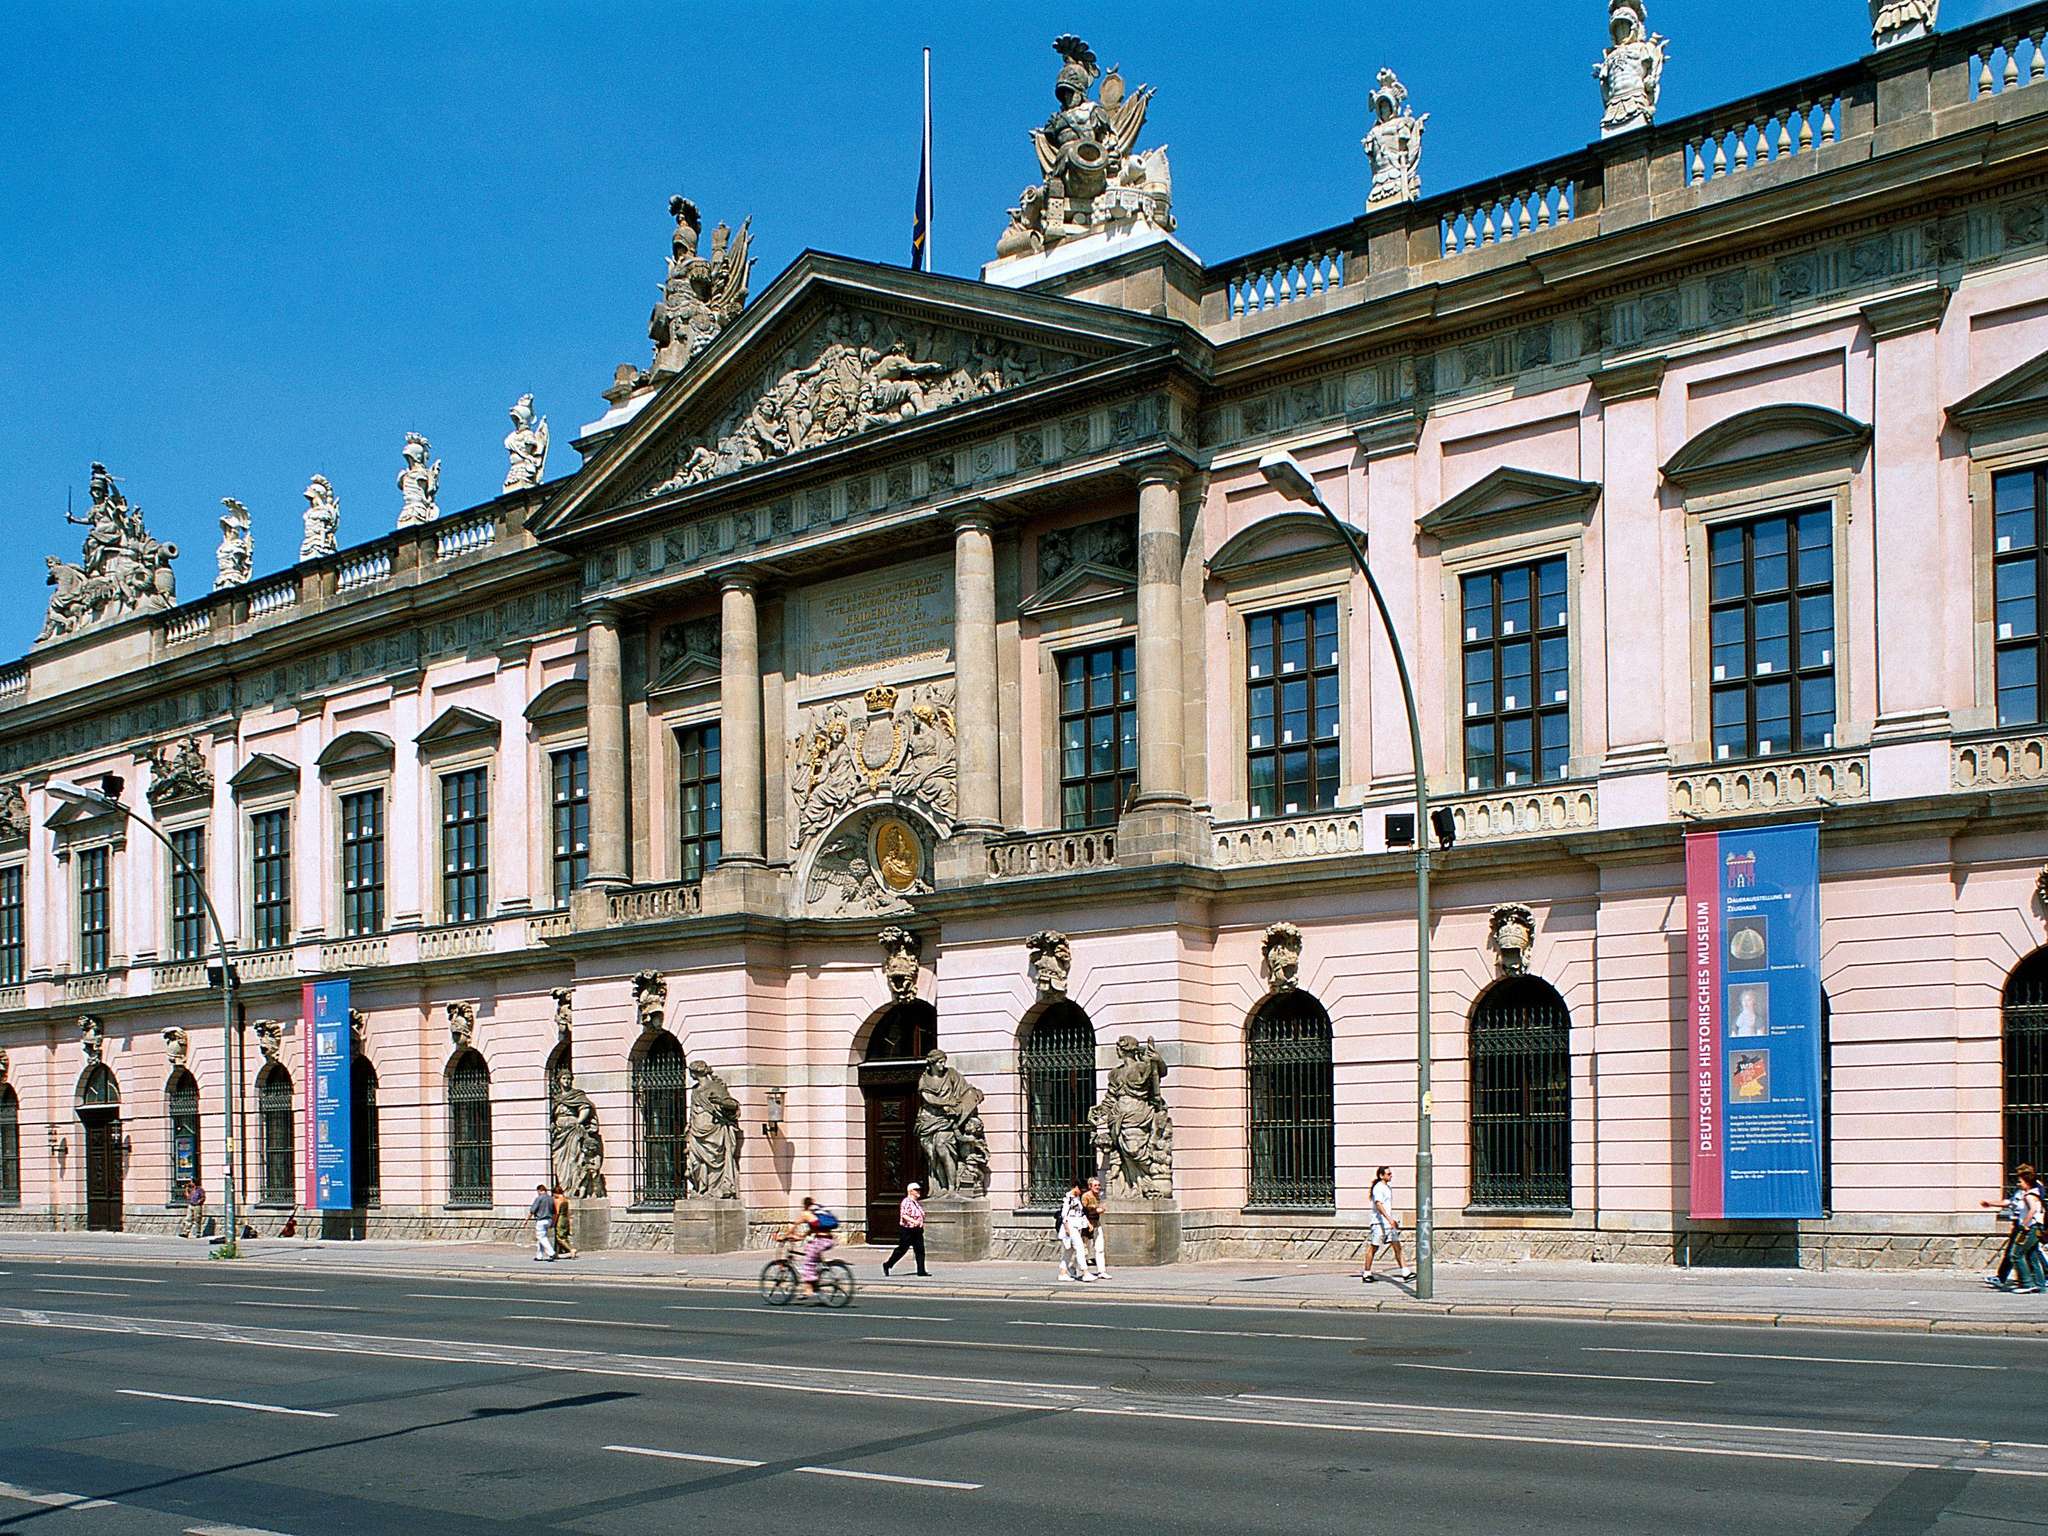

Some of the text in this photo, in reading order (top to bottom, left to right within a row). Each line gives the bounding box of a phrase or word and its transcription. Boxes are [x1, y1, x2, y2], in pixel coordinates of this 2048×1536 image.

[1697, 902, 1709, 965] MUSEUM
[1698, 969, 1711, 1067] HISTORISCHES
[1699, 1072, 1711, 1151] DEUTSCHES
